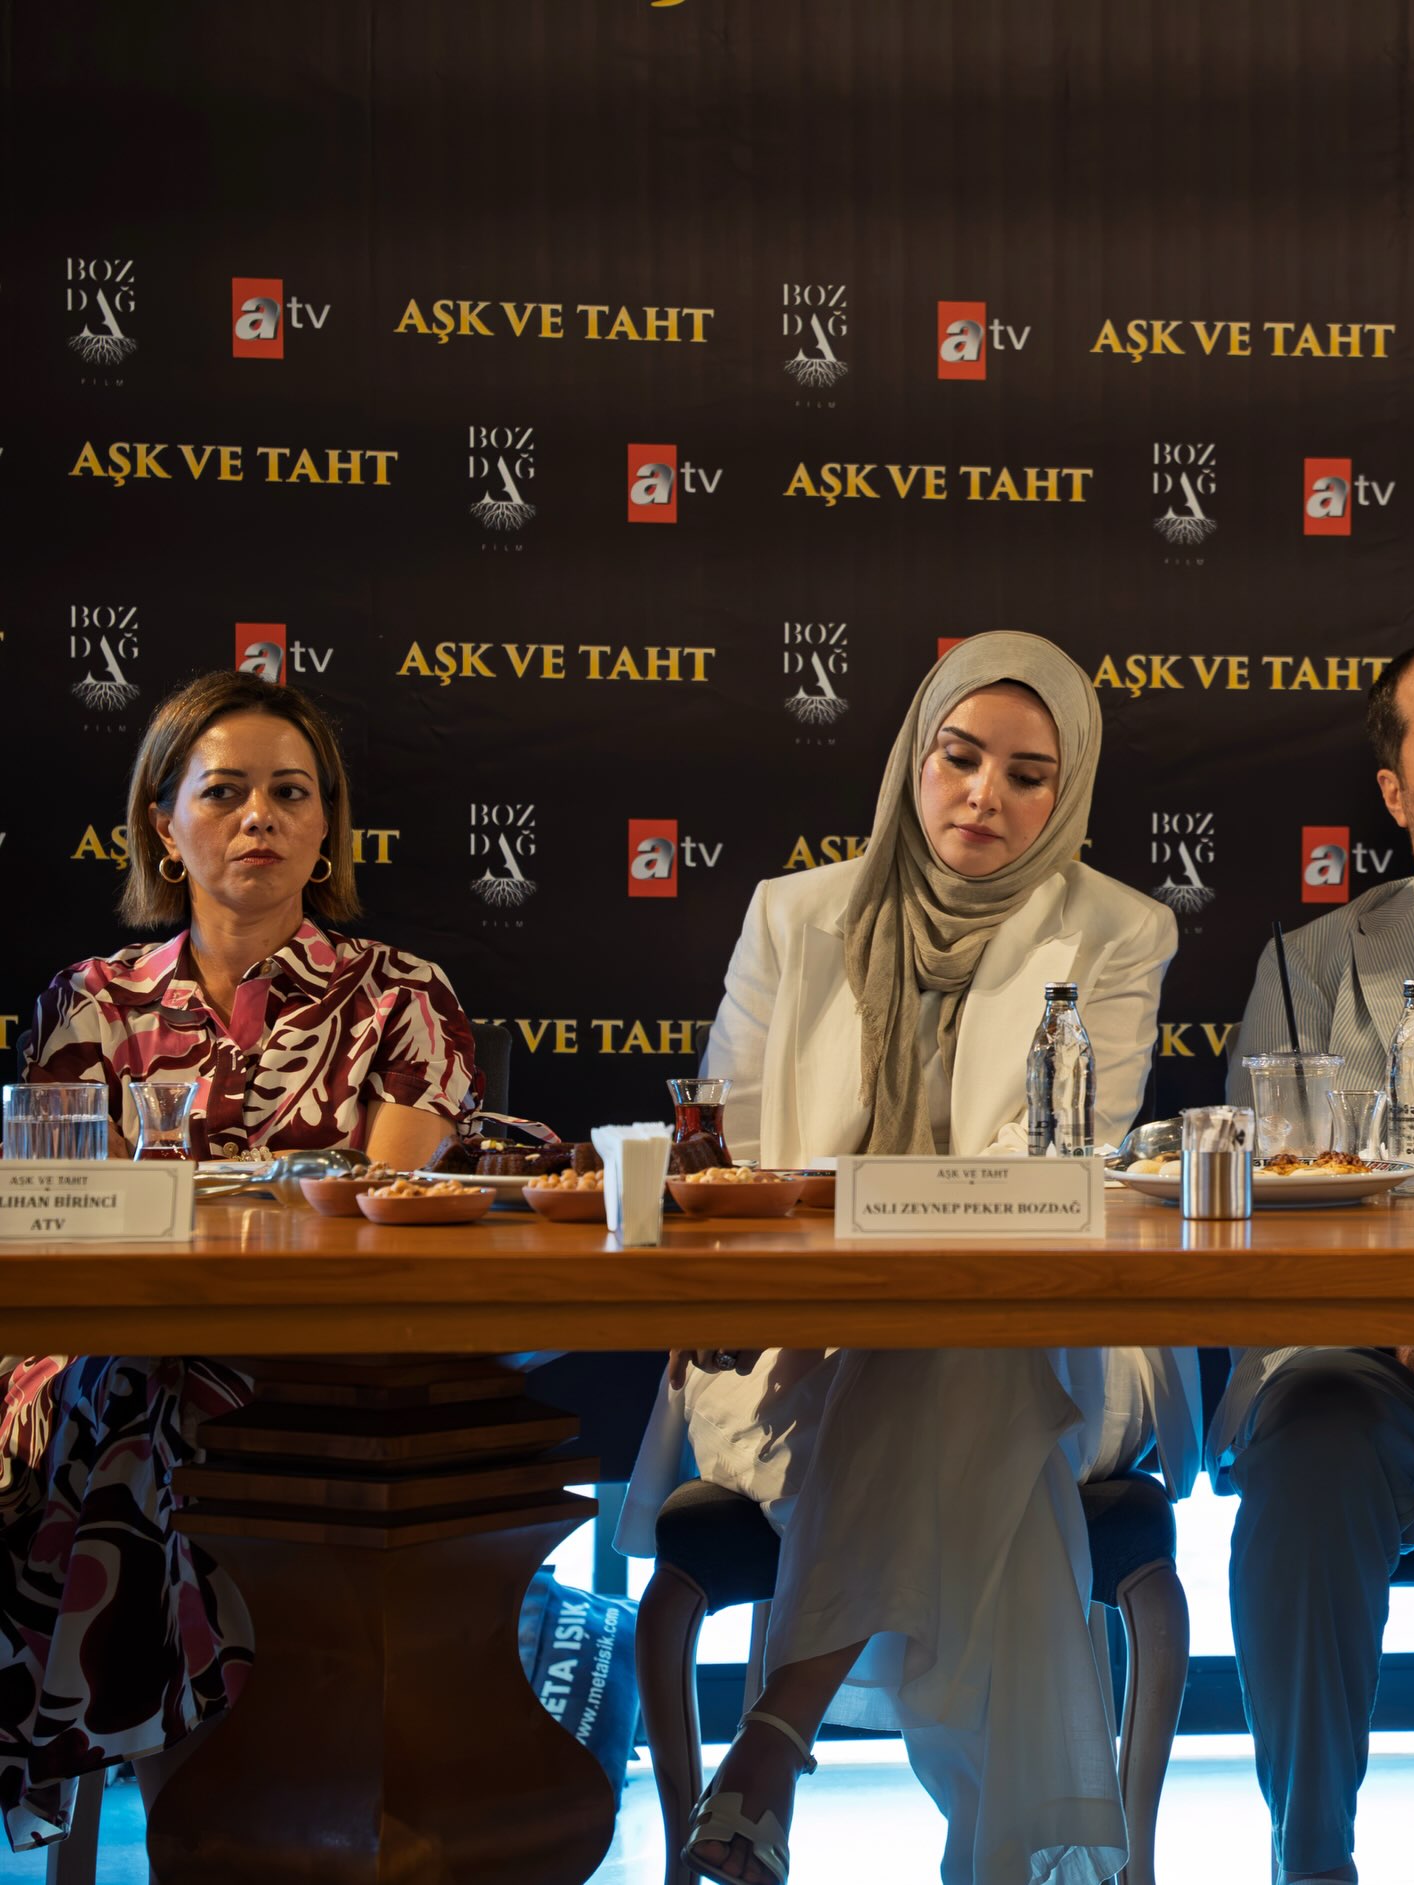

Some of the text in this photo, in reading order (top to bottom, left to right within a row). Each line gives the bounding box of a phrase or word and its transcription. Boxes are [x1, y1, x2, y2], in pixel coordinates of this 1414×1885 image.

[68, 258, 134, 282] BOZ
[784, 284, 846, 307] BOZ
[235, 297, 330, 340] atv
[394, 299, 715, 344] AŞK VE TAHT
[940, 319, 1031, 362] atv
[1089, 319, 1396, 363] AŞK VE TAHT
[470, 426, 534, 449] BOZ
[1154, 443, 1215, 465] BOZ
[70, 442, 398, 487] AŞK VE TAHT
[630, 462, 722, 505] atv
[783, 463, 1093, 507] AŞK VE TAHT
[1306, 475, 1395, 518] atv
[71, 605, 138, 629] BOZ
[785, 622, 847, 645] BOZ
[239, 641, 333, 683] atv
[396, 641, 716, 686] AŞK VE TAHT
[1093, 654, 1393, 698] AŞK VE TAHT
[471, 804, 535, 826] BOZ
[1153, 813, 1214, 834] BOZ
[70, 823, 128, 869] AŞ
[631, 837, 723, 880] atv
[1304, 843, 1393, 887] atv
[515, 1018, 714, 1054] VE TAH
[963, 1169, 977, 1178] VE
[981, 1169, 1009, 1178] TAHT
[54, 1194, 117, 1208] BİRİNCİ
[863, 1200, 1081, 1215] ASLI ZEYNEP PEKER BOZDAĞ
[30, 1218, 66, 1231] ATV
[540, 1659, 578, 1723] ETA
[576, 1607, 620, 1746] ww.metaisik.com
